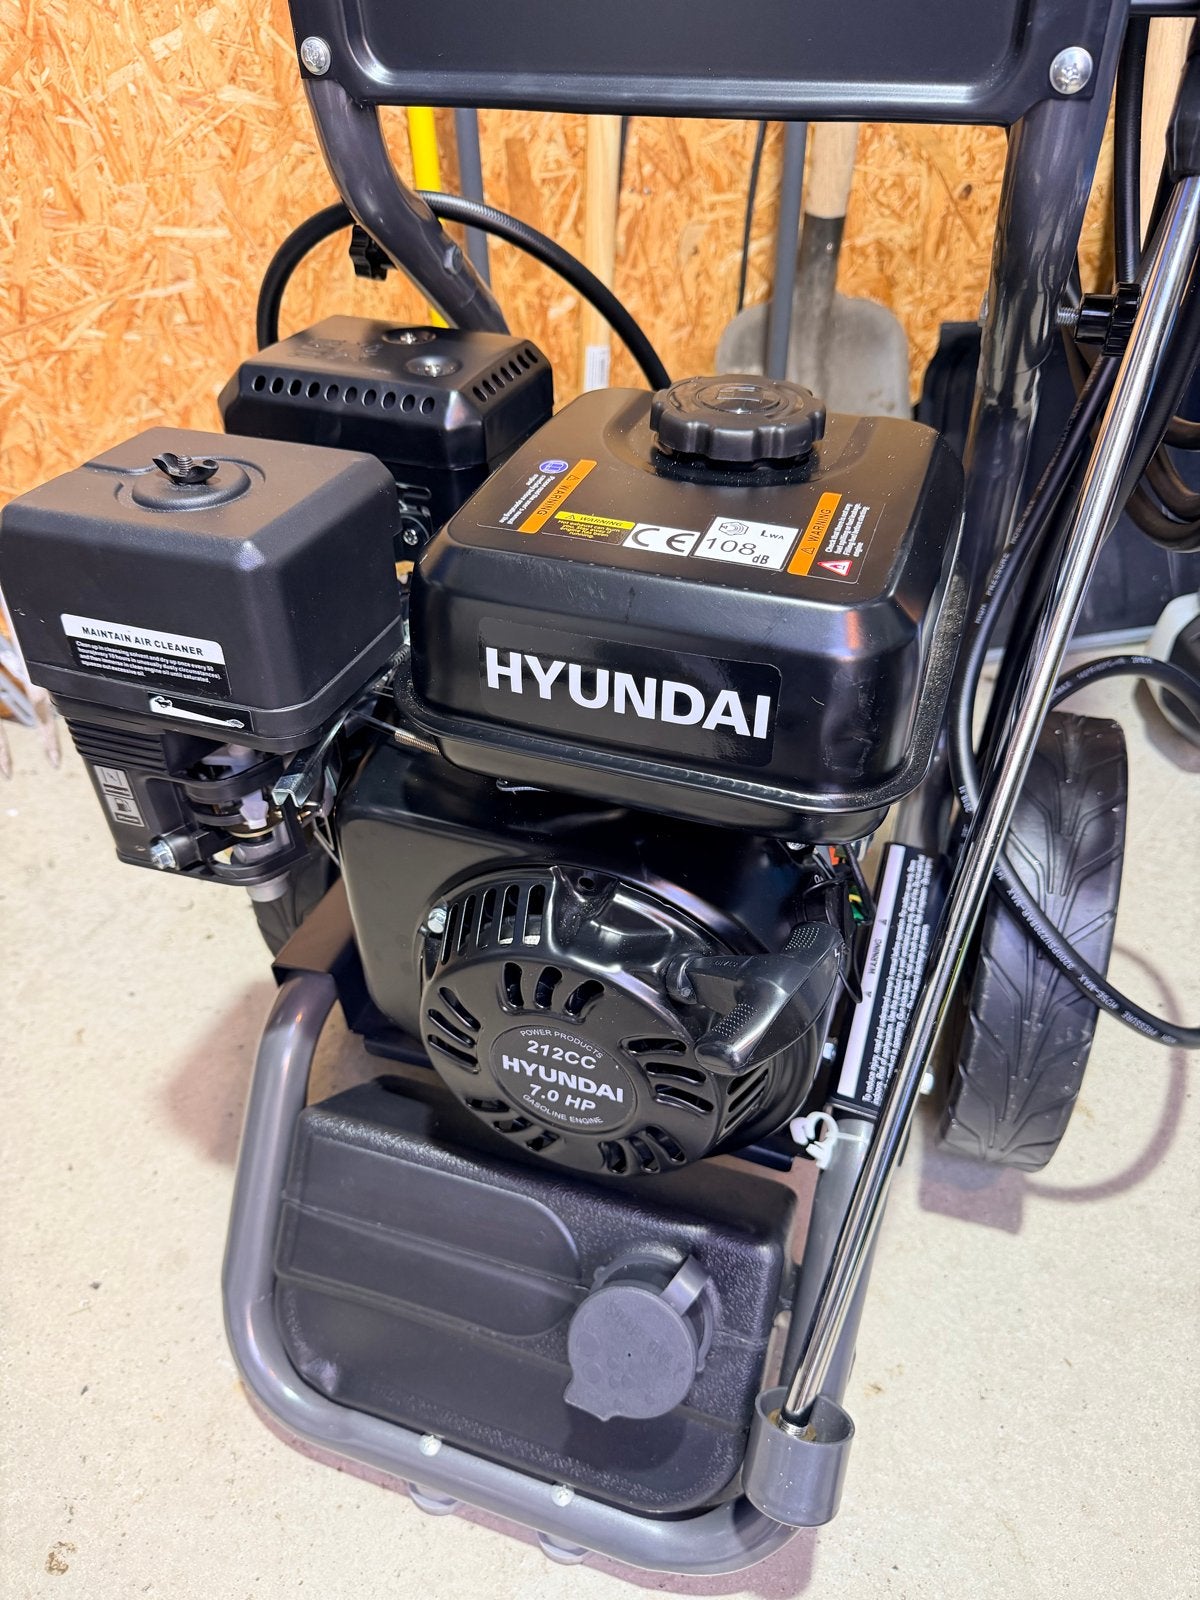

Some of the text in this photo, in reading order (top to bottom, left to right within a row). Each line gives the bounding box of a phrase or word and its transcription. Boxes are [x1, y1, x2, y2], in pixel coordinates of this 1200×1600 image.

[537, 485, 571, 516] WARNING
[580, 517, 623, 527] WARNING
[808, 508, 832, 542] WARNING
[706, 538, 756, 556] 108
[752, 554, 770, 565] dB
[82, 626, 204, 656] MAINTAIN AIR CLEANER
[485, 646, 771, 740] HYUNDAI
[868, 938, 882, 974] WARNING
[1077, 973, 1120, 1011] HOSE-MAX
[1120, 1010, 1158, 1037] PRESSURE
[519, 1029, 603, 1059] POWER PRODUCTS
[526, 1040, 597, 1069] 212CC
[502, 1054, 624, 1103] HYUNDAI
[522, 1094, 604, 1125] GASOLINE ENGINE
[529, 1083, 597, 1111] 7.0 HP
